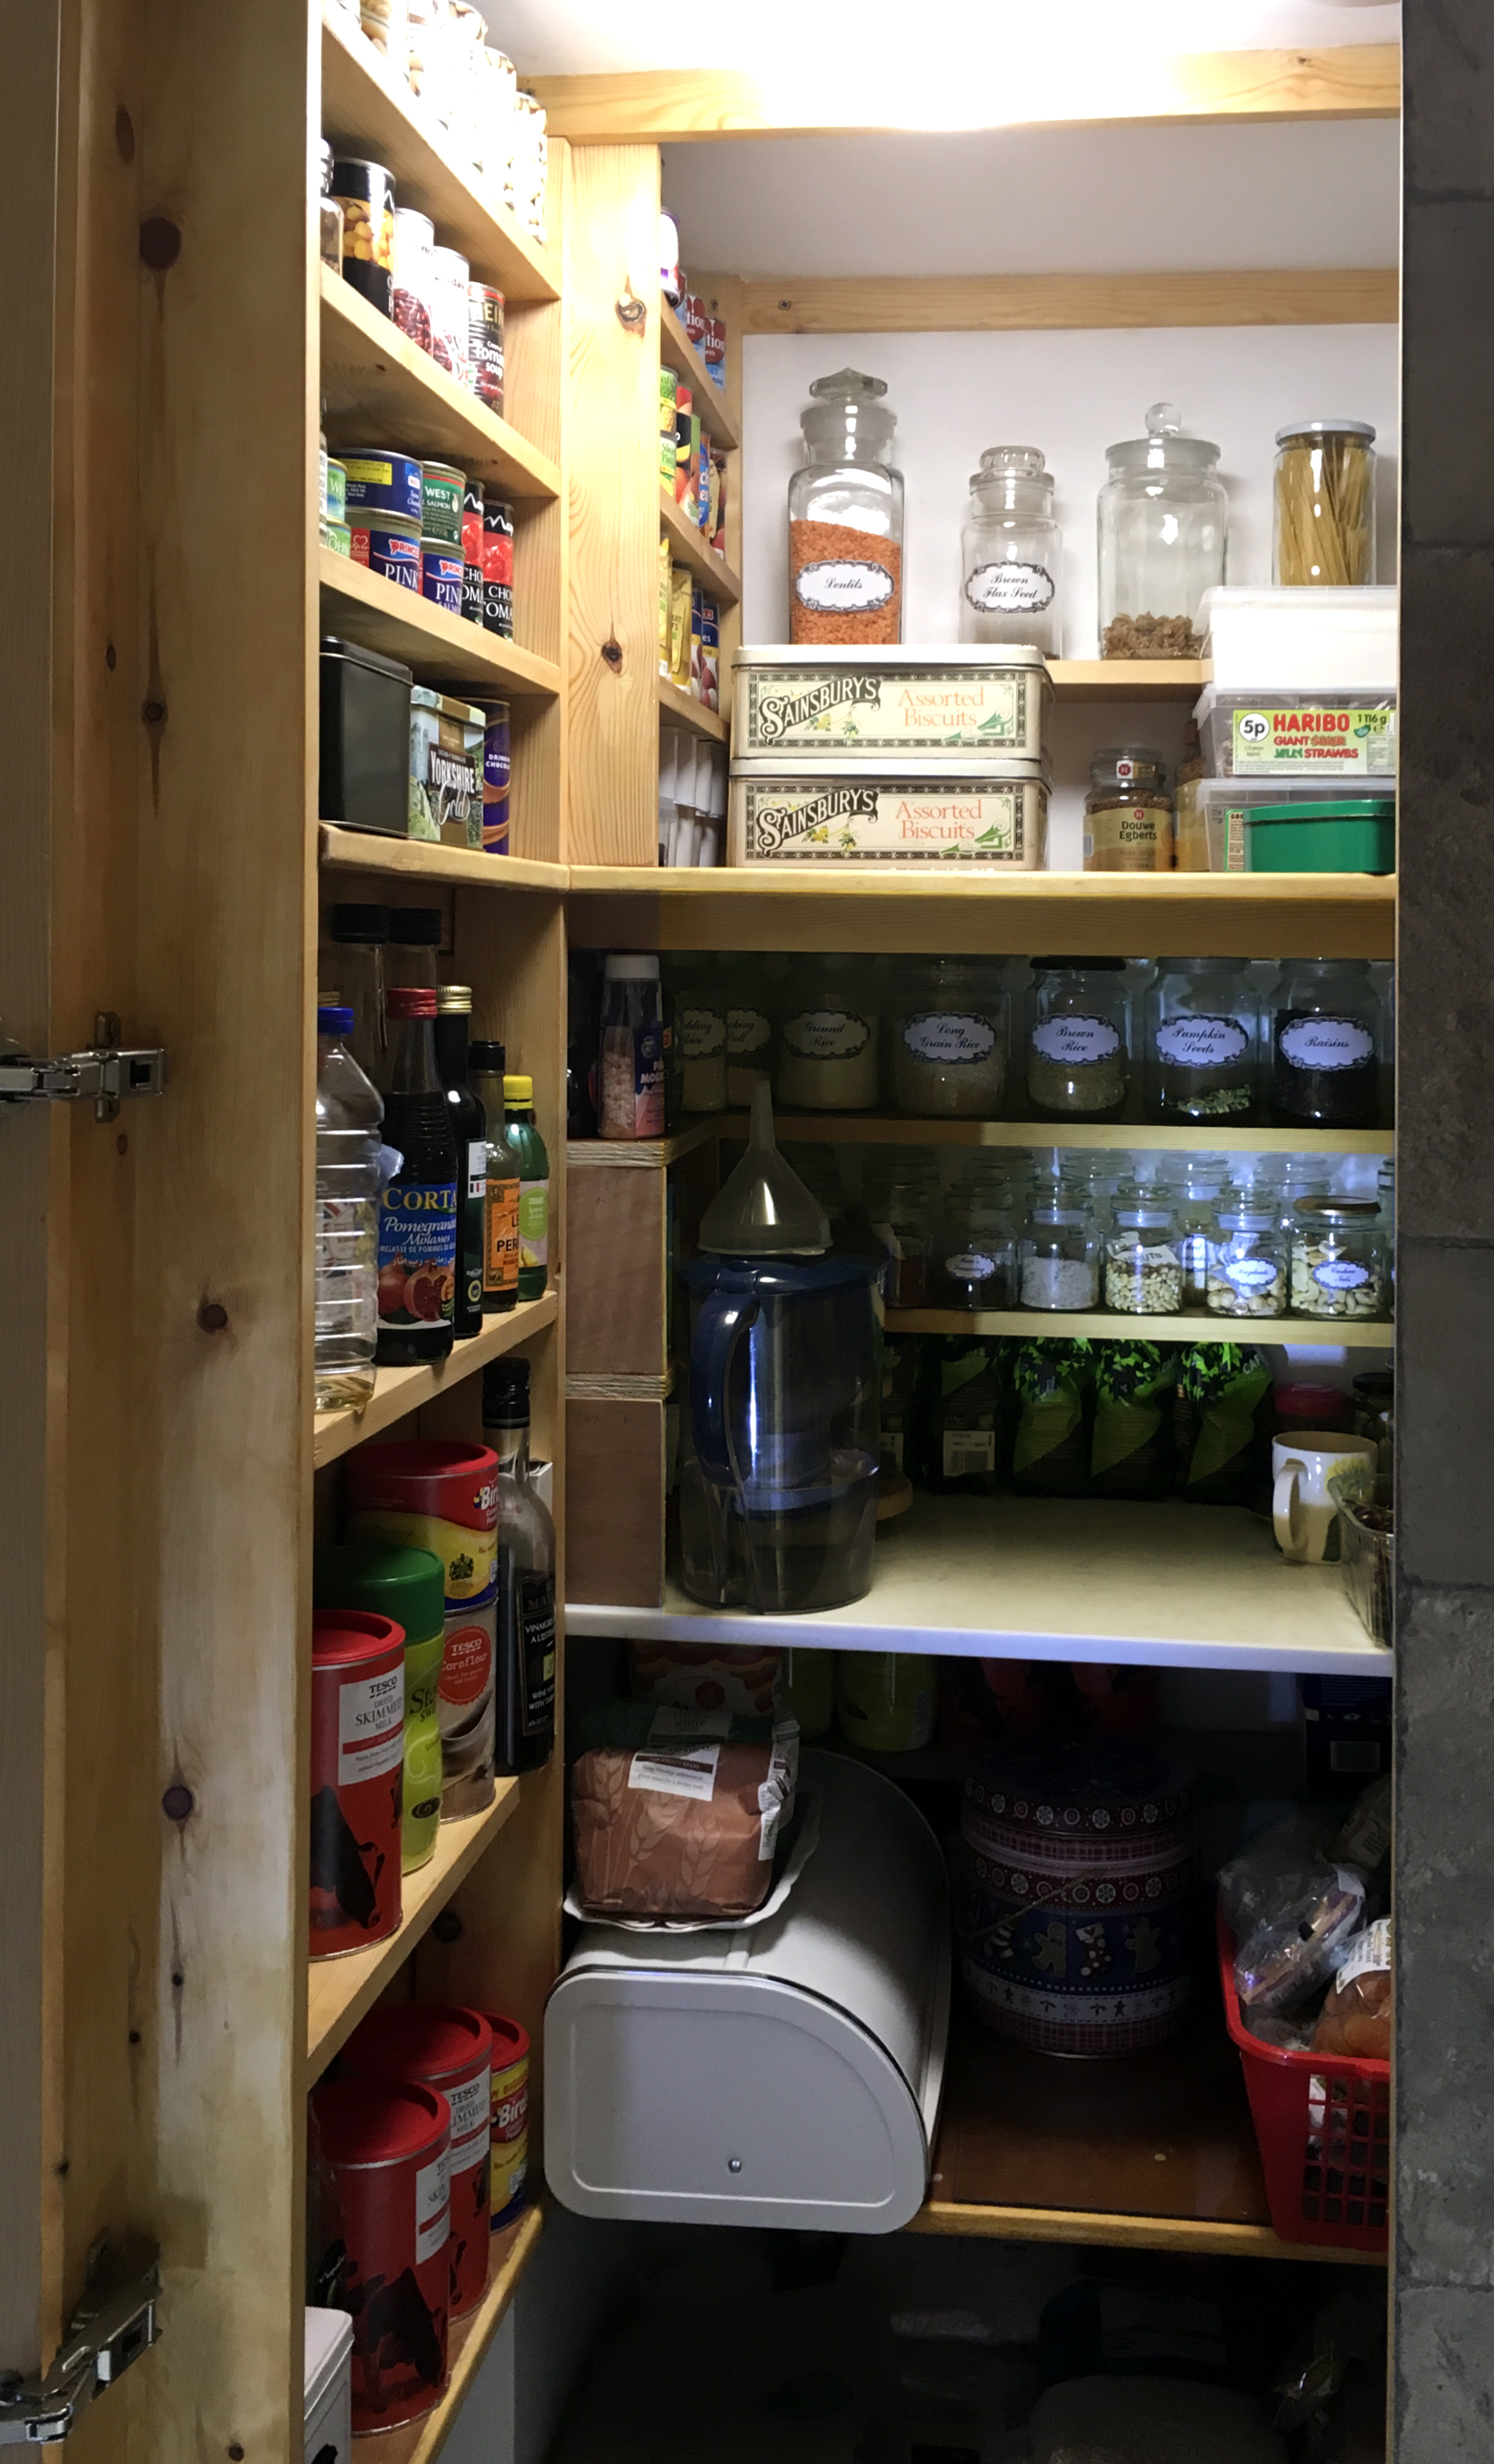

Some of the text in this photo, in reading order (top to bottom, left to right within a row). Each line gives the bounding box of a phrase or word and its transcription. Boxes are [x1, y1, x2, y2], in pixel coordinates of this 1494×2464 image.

[427, 501, 451, 510] SALMON
[825, 578, 863, 590] Lentils
[990, 573, 1029, 585] Brown
[983, 586, 1038, 600] Flax Seed
[899, 686, 984, 707] Assorted
[761, 676, 880, 744] SAINSBURY'S
[904, 708, 978, 727] Biscuits
[1273, 713, 1350, 732] HARIBO
[1243, 720, 1265, 737] 5p
[1273, 736, 1309, 746] GIANT
[1304, 748, 1359, 758] STRAWBS
[430, 750, 475, 794] YORKSHIRE
[896, 799, 982, 820] Assorted
[758, 789, 877, 856] SAINSBURY'S
[1122, 821, 1155, 830] Douwe
[901, 821, 975, 840] Biscuits
[1119, 831, 1157, 842] Egberts
[683, 1019, 712, 1035] dding
[804, 1021, 846, 1033] Ground
[937, 1023, 965, 1038] Long
[1054, 1026, 1095, 1038] Brown
[1172, 1027, 1226, 1041] Pumpkin
[810, 1036, 836, 1047] Rice
[920, 1036, 981, 1049] Grain Rice
[1061, 1041, 1088, 1053] Rice
[1182, 1041, 1215, 1054] Seeds
[1304, 1036, 1350, 1049] Raisins
[402, 1233, 451, 1245] Molasses
[451, 1638, 482, 1654] TESCO
[369, 1675, 397, 1694] TESCO
[355, 1696, 402, 1727] SKIMMED
[451, 2083, 480, 2102] TESCO
